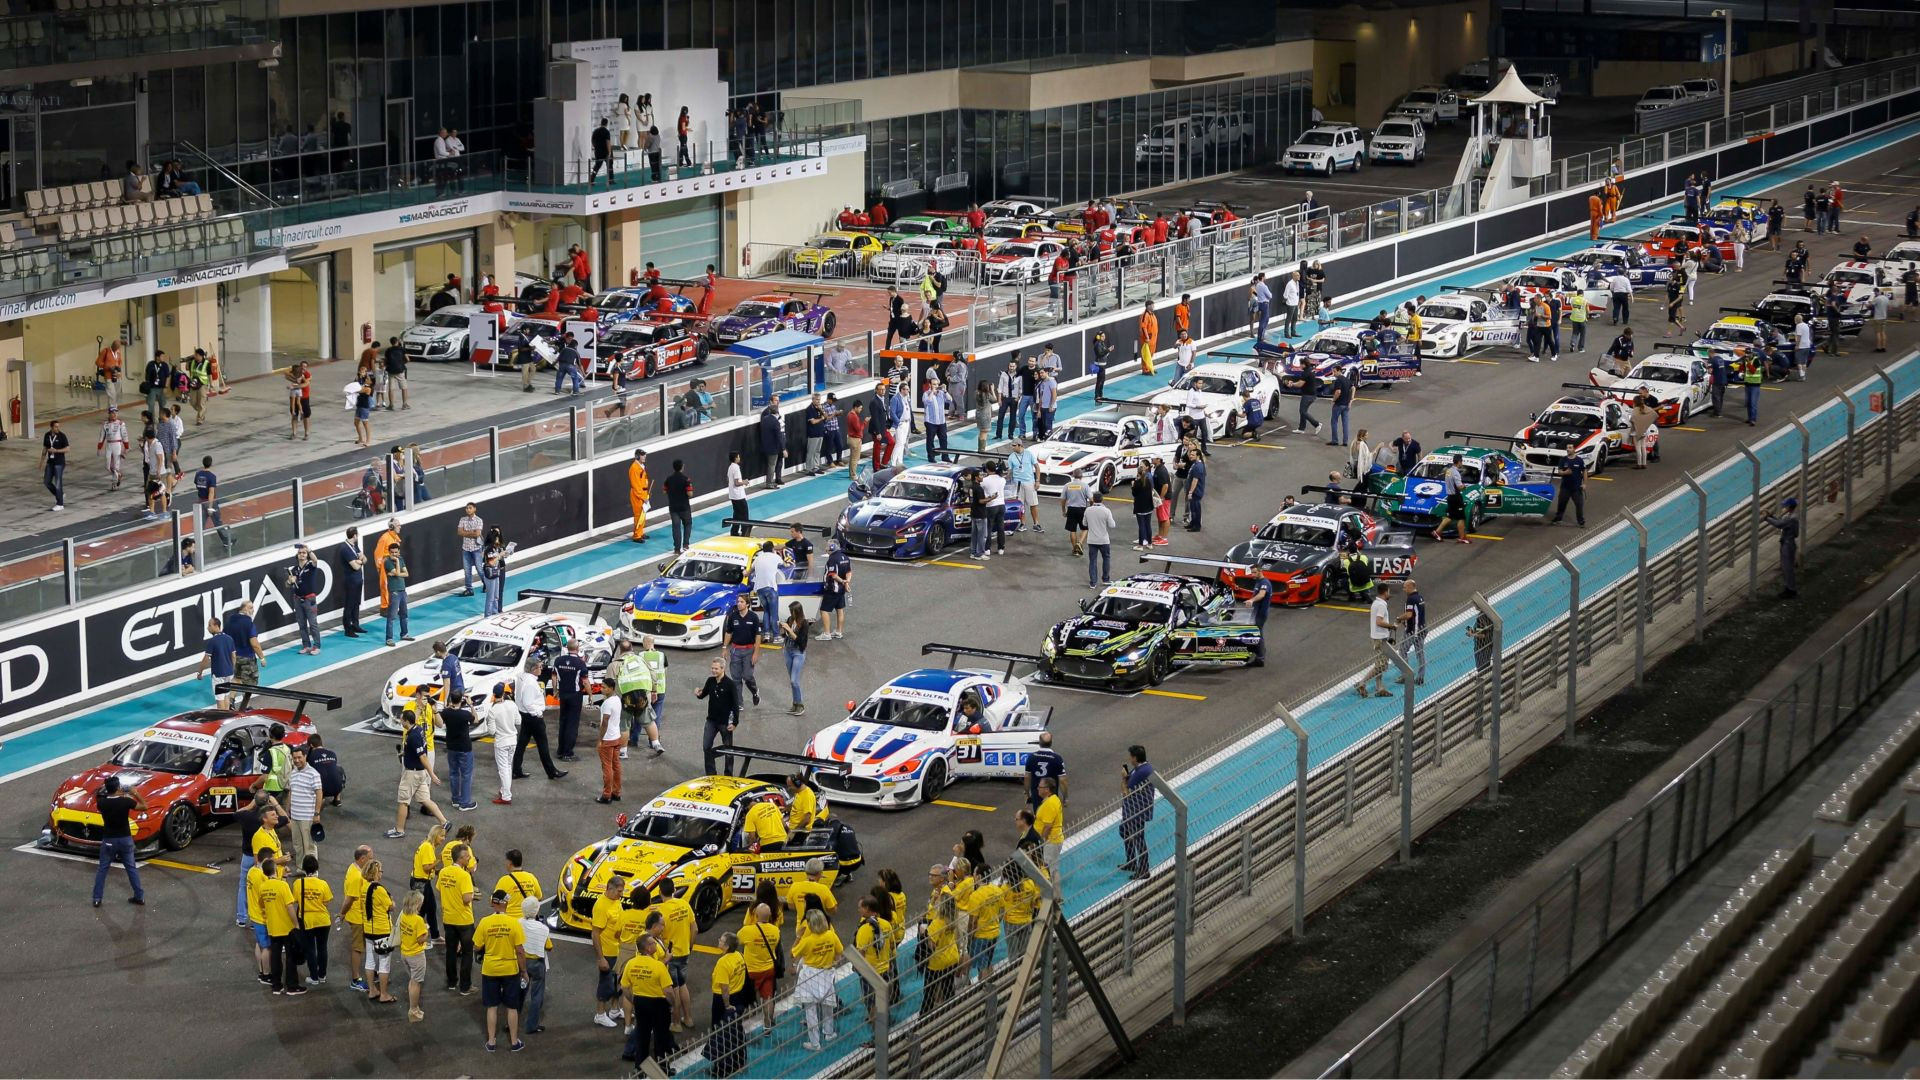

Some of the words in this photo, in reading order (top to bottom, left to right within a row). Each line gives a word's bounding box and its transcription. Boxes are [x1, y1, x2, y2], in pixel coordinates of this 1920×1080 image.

[0, 95, 61, 106] MASEATI
[488, 320, 496, 340] 1
[584, 328, 595, 349] 2
[1536, 430, 1581, 439] KLOS
[1123, 457, 1139, 465] 46
[1488, 495, 1497, 504] 5
[956, 514, 971, 524] 95
[1181, 637, 1191, 649] 7
[158, 731, 184, 740] HELIX
[184, 735, 210, 744] ULTRA
[957, 746, 977, 758] 31
[1035, 762, 1048, 776] 3
[214, 794, 232, 808] 14
[668, 801, 697, 810] HELIX
[698, 804, 729, 816] ULTRA
